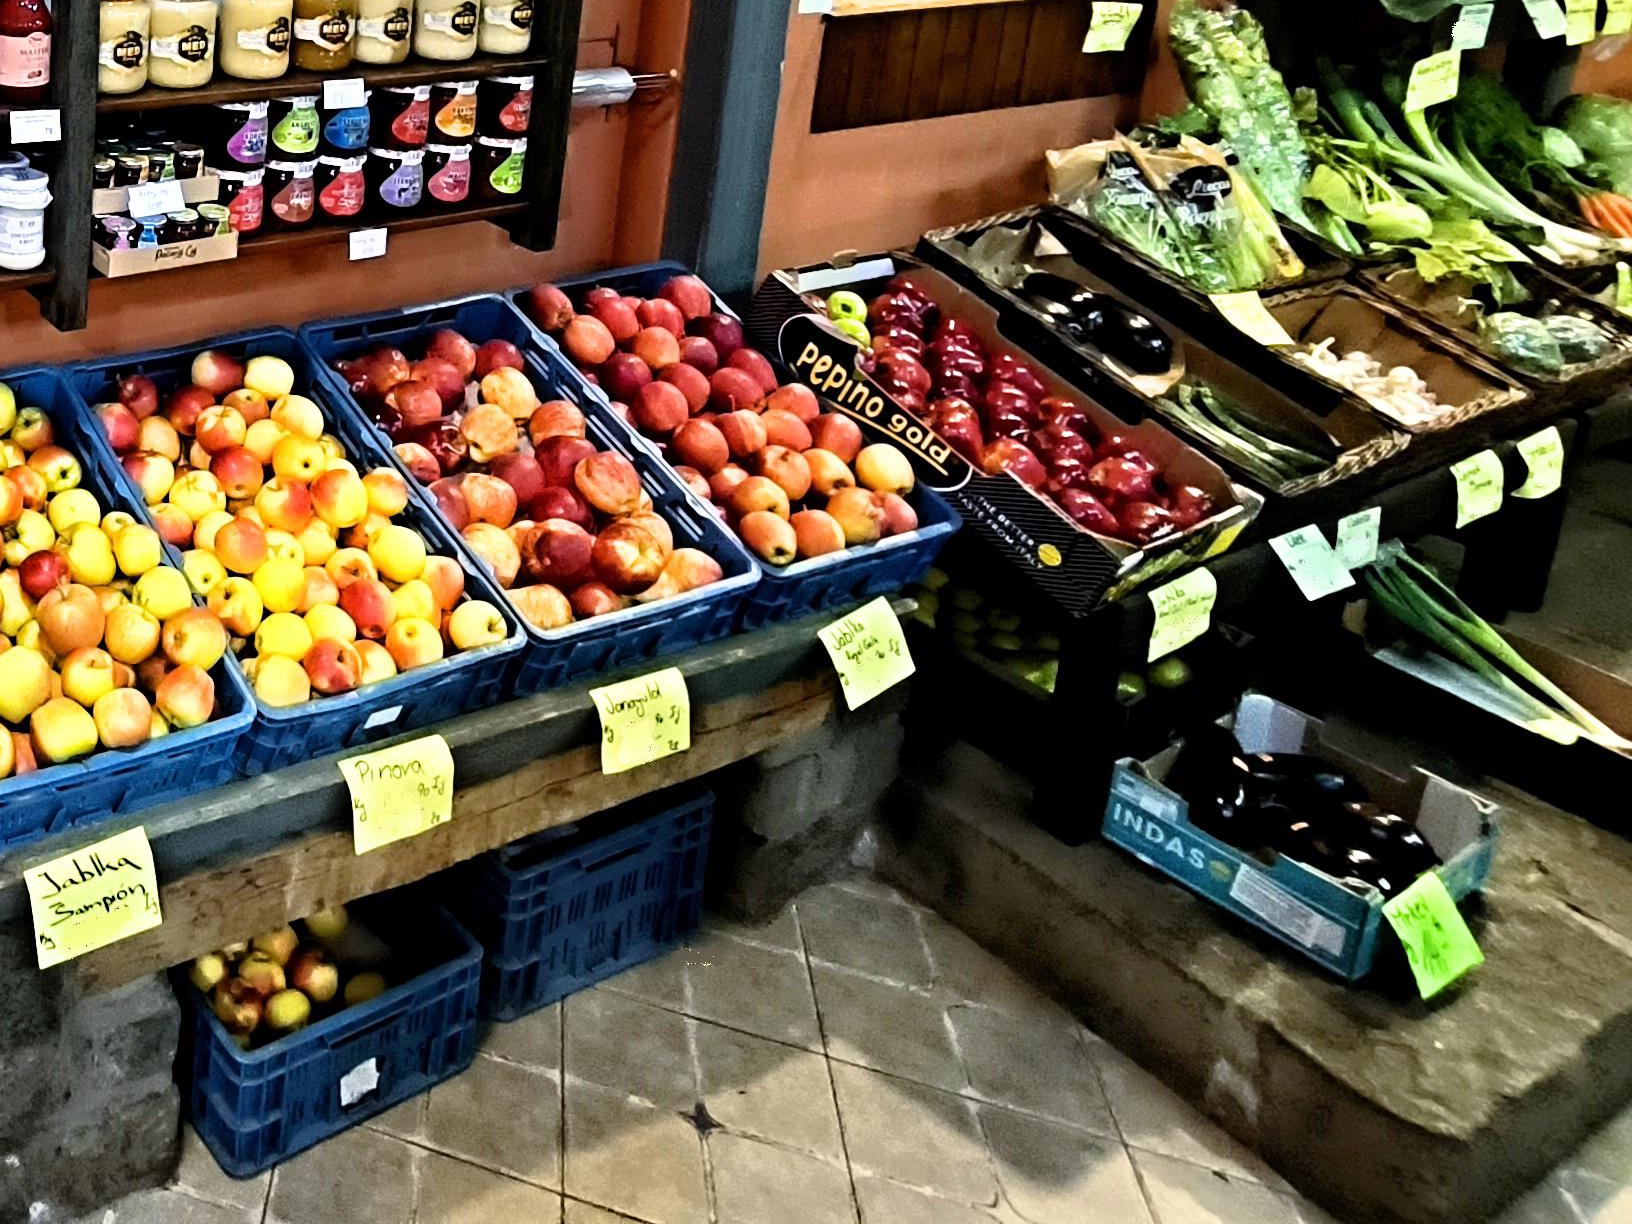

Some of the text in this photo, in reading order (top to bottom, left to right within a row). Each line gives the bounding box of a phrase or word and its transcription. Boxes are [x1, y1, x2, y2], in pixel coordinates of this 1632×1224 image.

[181, 39, 206, 52] MED
[886, 413, 952, 465] gold
[354, 760, 426, 784] Pinova
[1112, 801, 1206, 871] INDAS
[37, 852, 143, 901] Jablka
